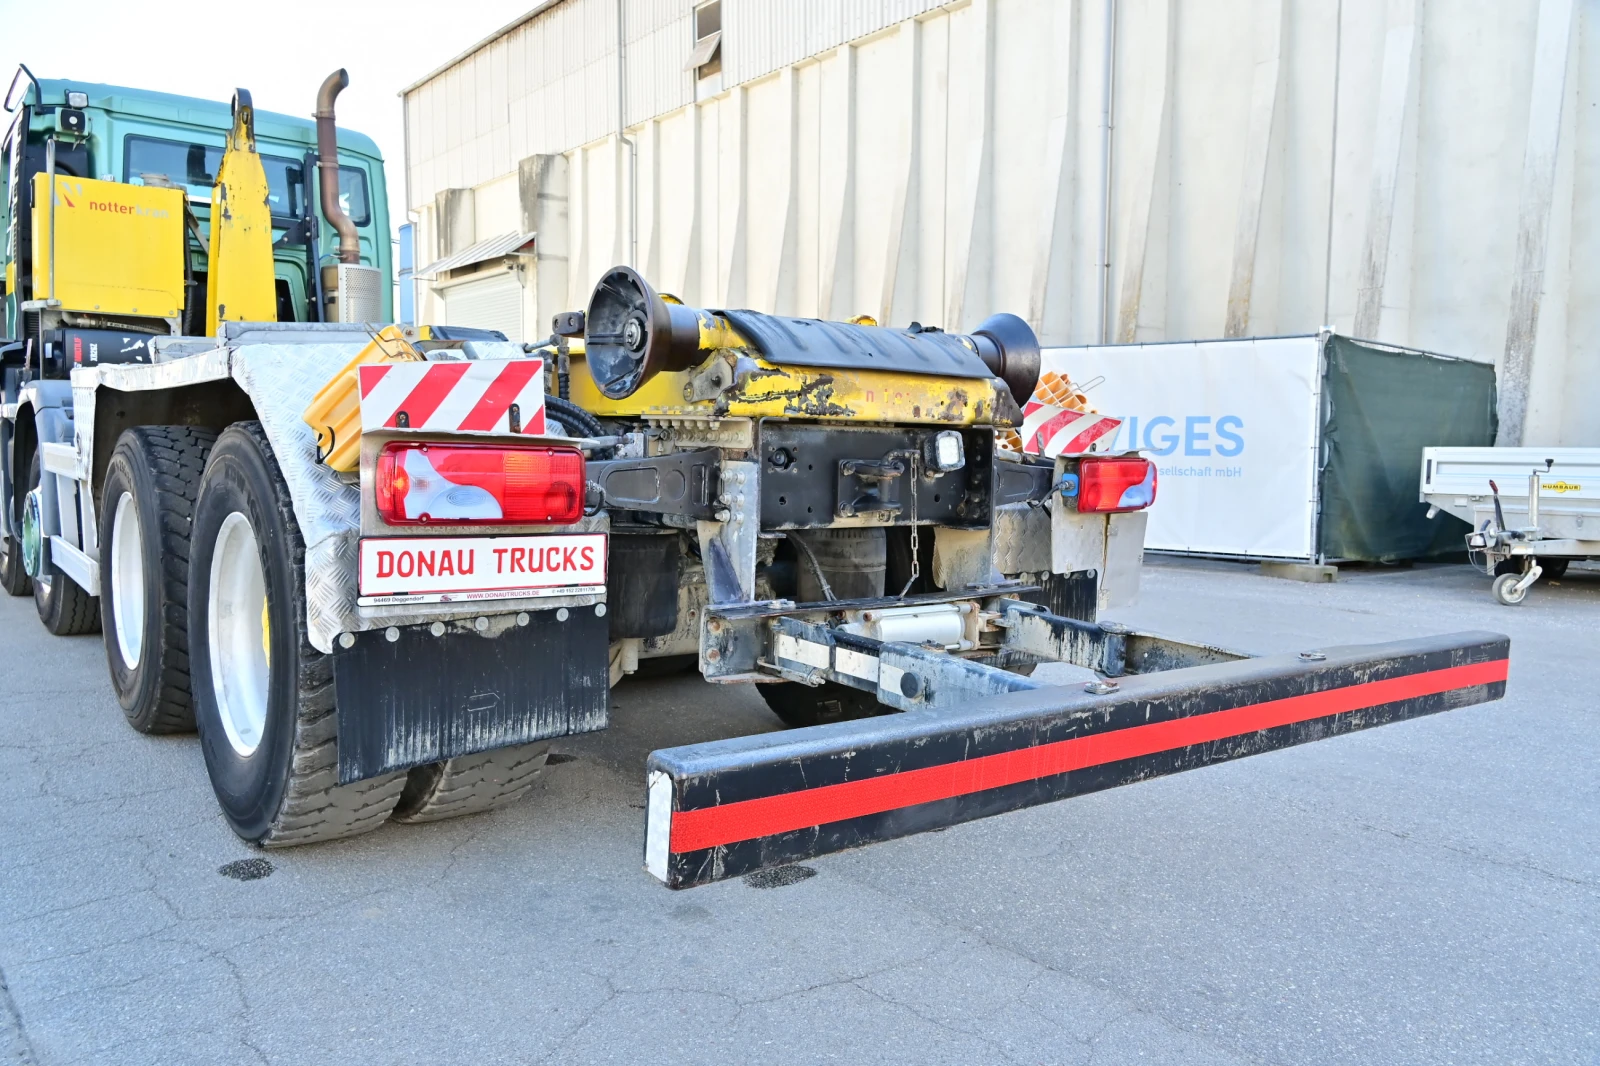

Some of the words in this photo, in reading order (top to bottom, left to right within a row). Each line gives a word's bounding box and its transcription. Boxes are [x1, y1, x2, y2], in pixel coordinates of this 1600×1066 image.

[89, 201, 169, 218] notterkran
[1159, 466, 1212, 477] sellschaft
[1215, 466, 1242, 477] mbH
[376, 549, 475, 578] DONAU
[492, 546, 595, 574] TRUCKS
[391, 595, 425, 603] Deggendorf
[466, 590, 540, 600] WWW.DONAUTRUCKS.DE
